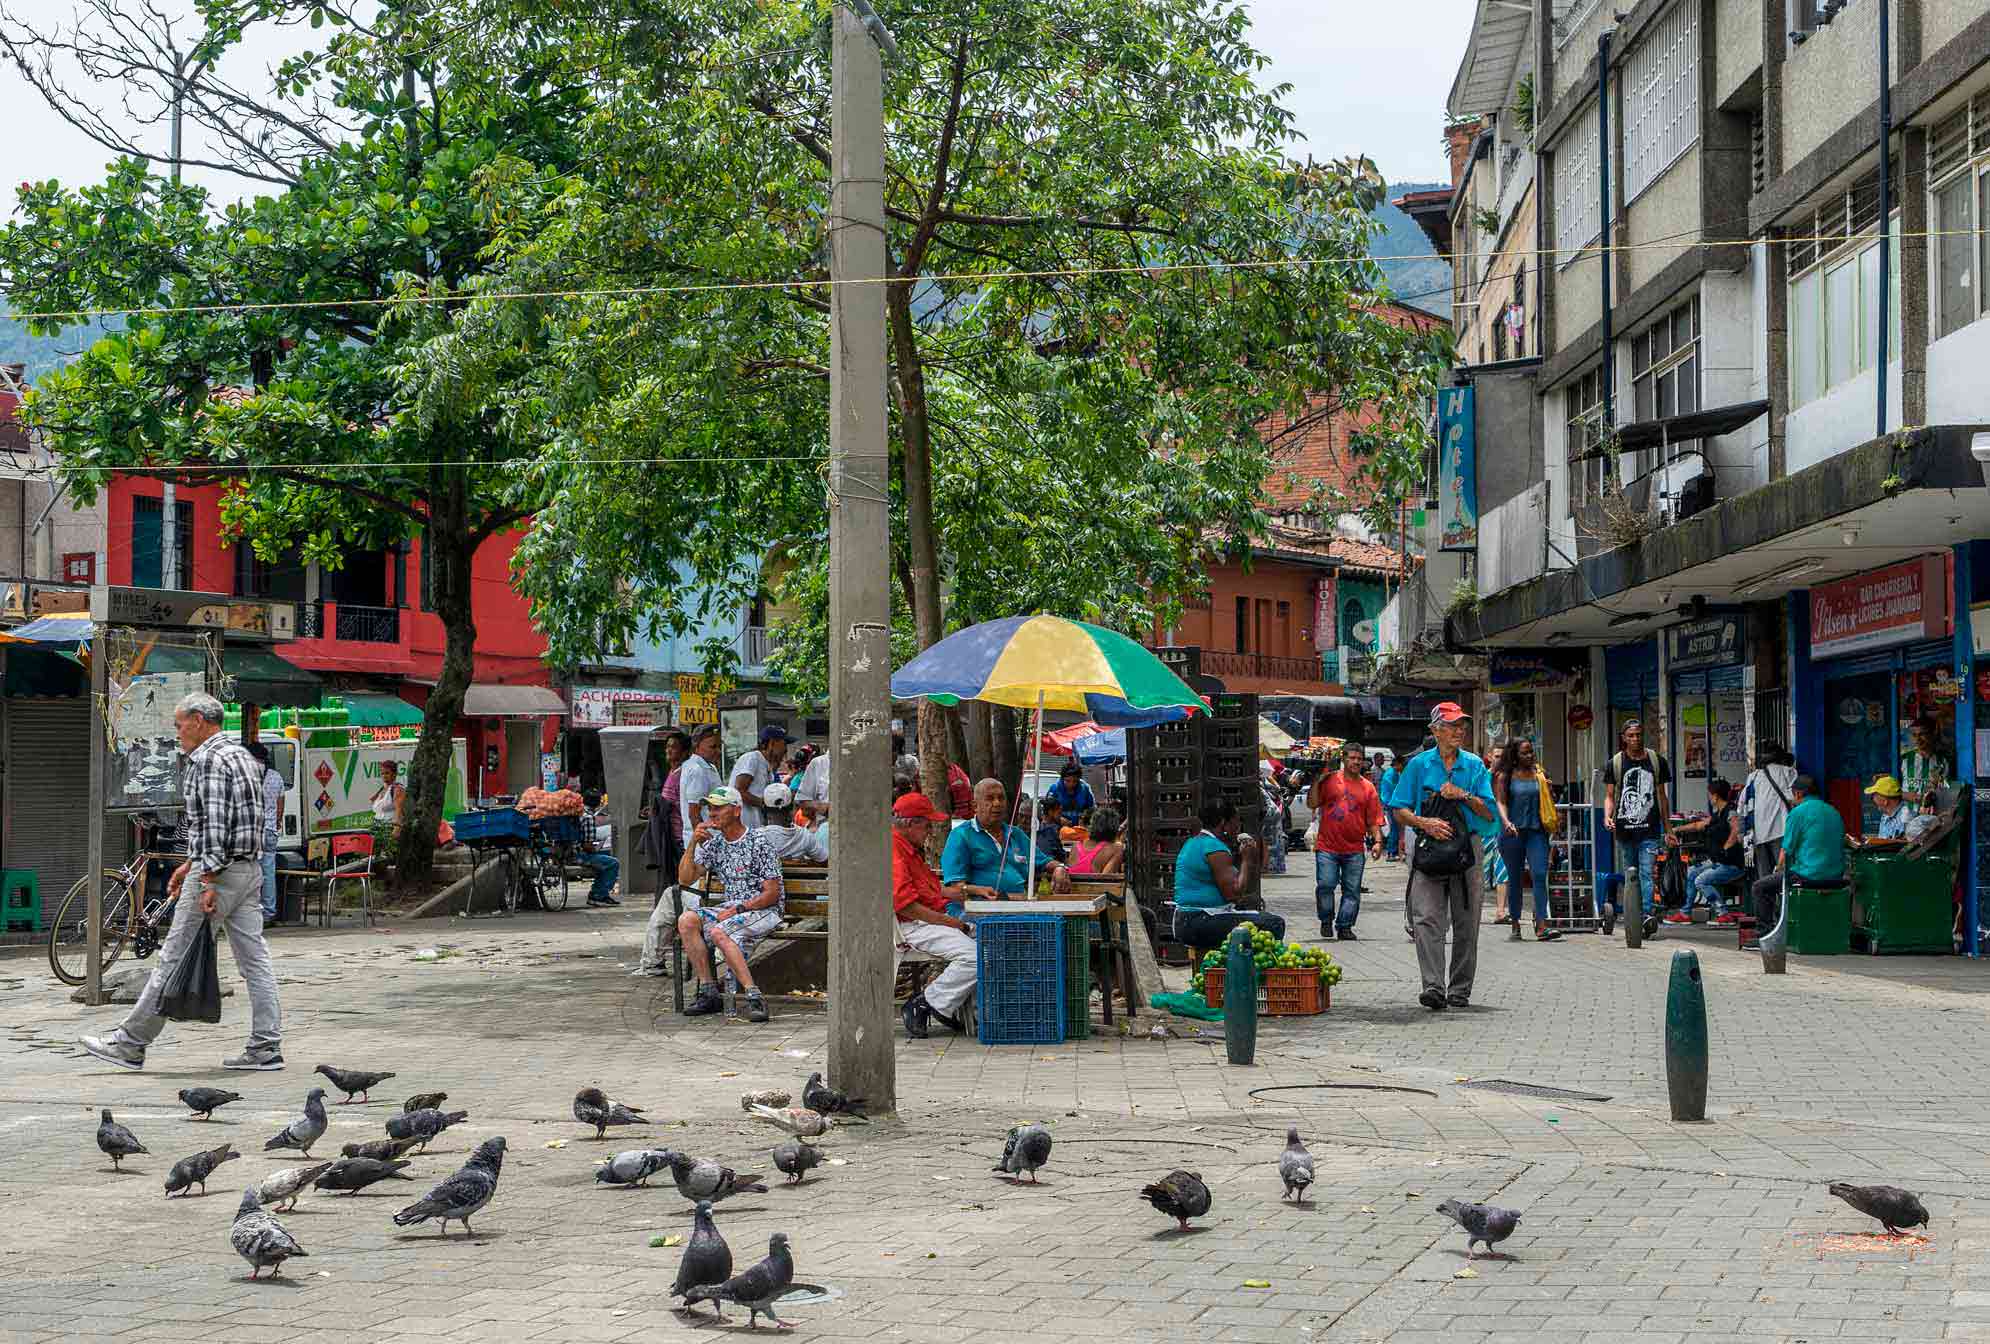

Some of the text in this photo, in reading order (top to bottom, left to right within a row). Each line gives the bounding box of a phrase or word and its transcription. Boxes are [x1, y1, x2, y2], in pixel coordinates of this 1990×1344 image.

[1814, 597, 1848, 640] Pilsen
[1858, 602, 1884, 624] LICORES
[1687, 635, 1716, 656] ASTRID
